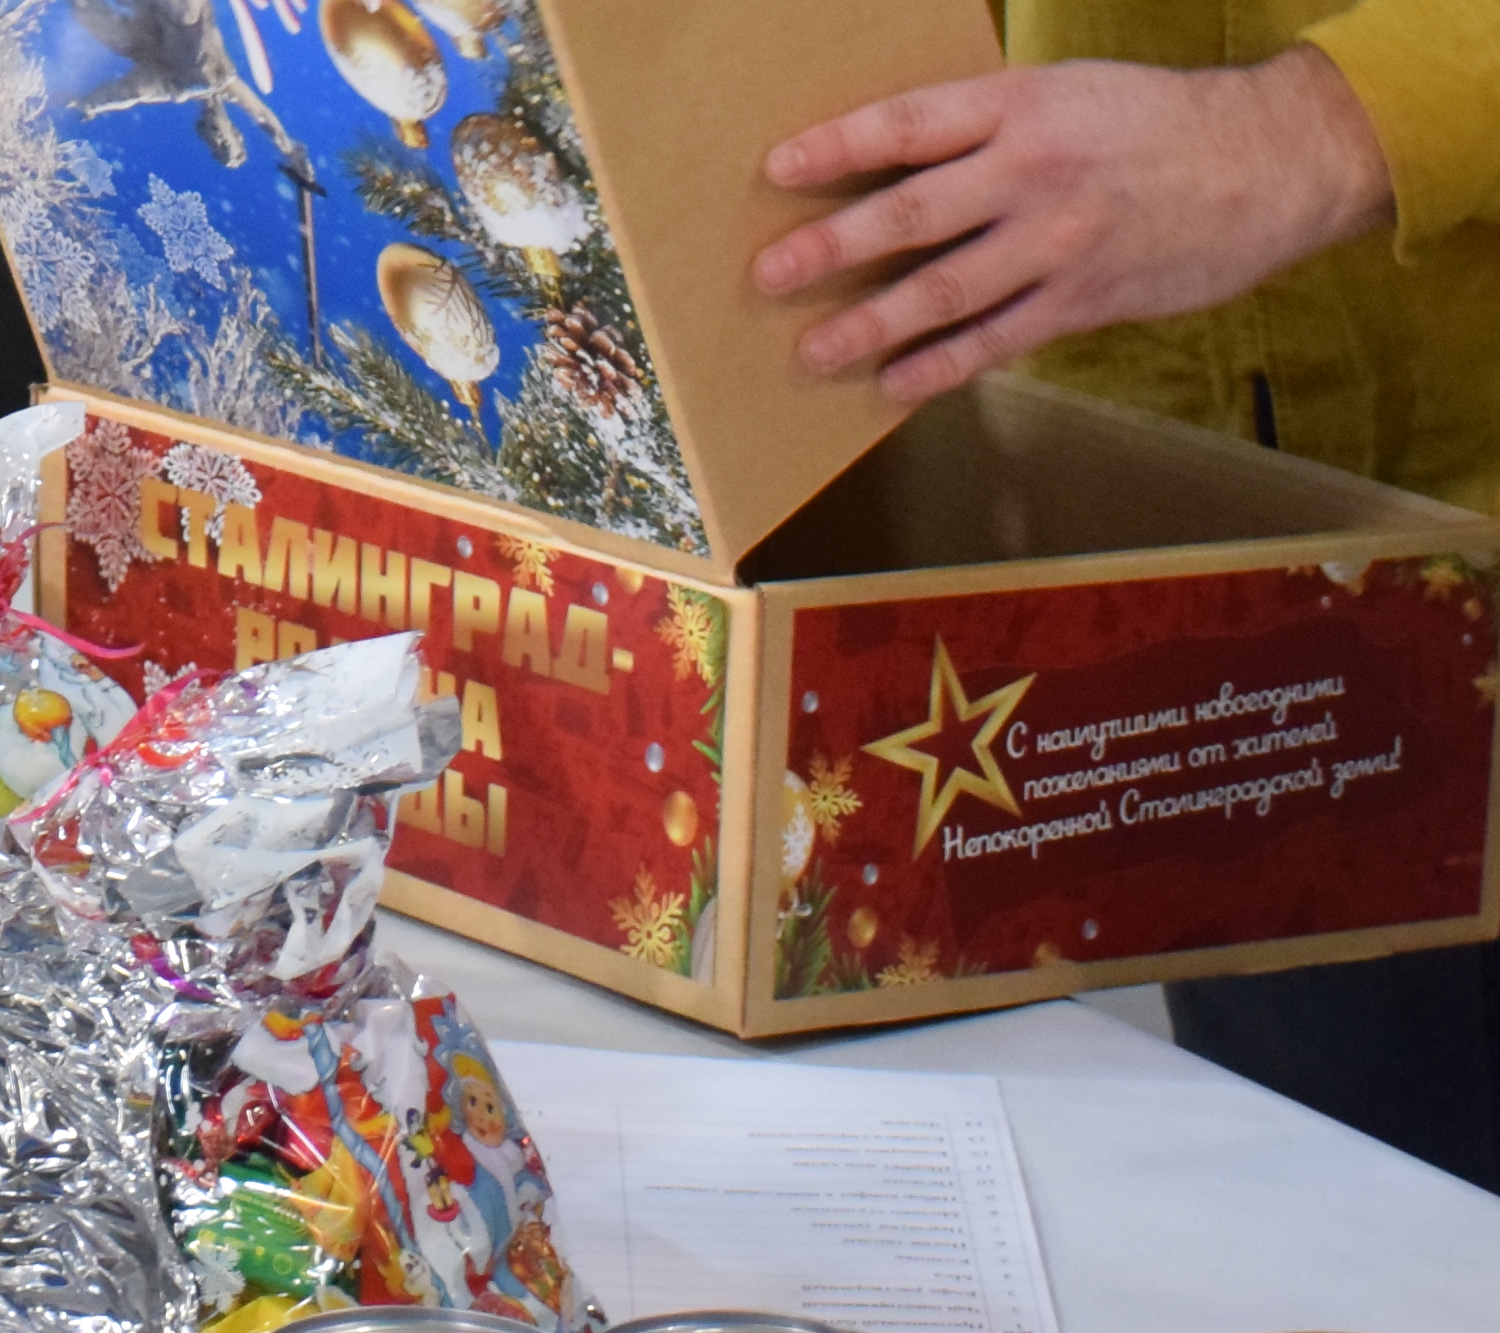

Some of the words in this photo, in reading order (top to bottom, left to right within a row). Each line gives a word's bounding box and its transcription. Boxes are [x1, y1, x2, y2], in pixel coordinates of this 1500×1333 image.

[139, 479, 635, 696] СТАЛИНГРАД-
[1005, 723, 1027, 759] С
[1035, 702, 1190, 761] наилучшими
[1193, 673, 1346, 723] новогодними
[1023, 749, 1182, 801] пожеланиями
[1187, 741, 1226, 770] от
[1232, 712, 1339, 762] жителей
[942, 807, 1113, 862] Непокоренной
[1118, 760, 1324, 826] Сталинградской
[1329, 735, 1403, 797] земли!
